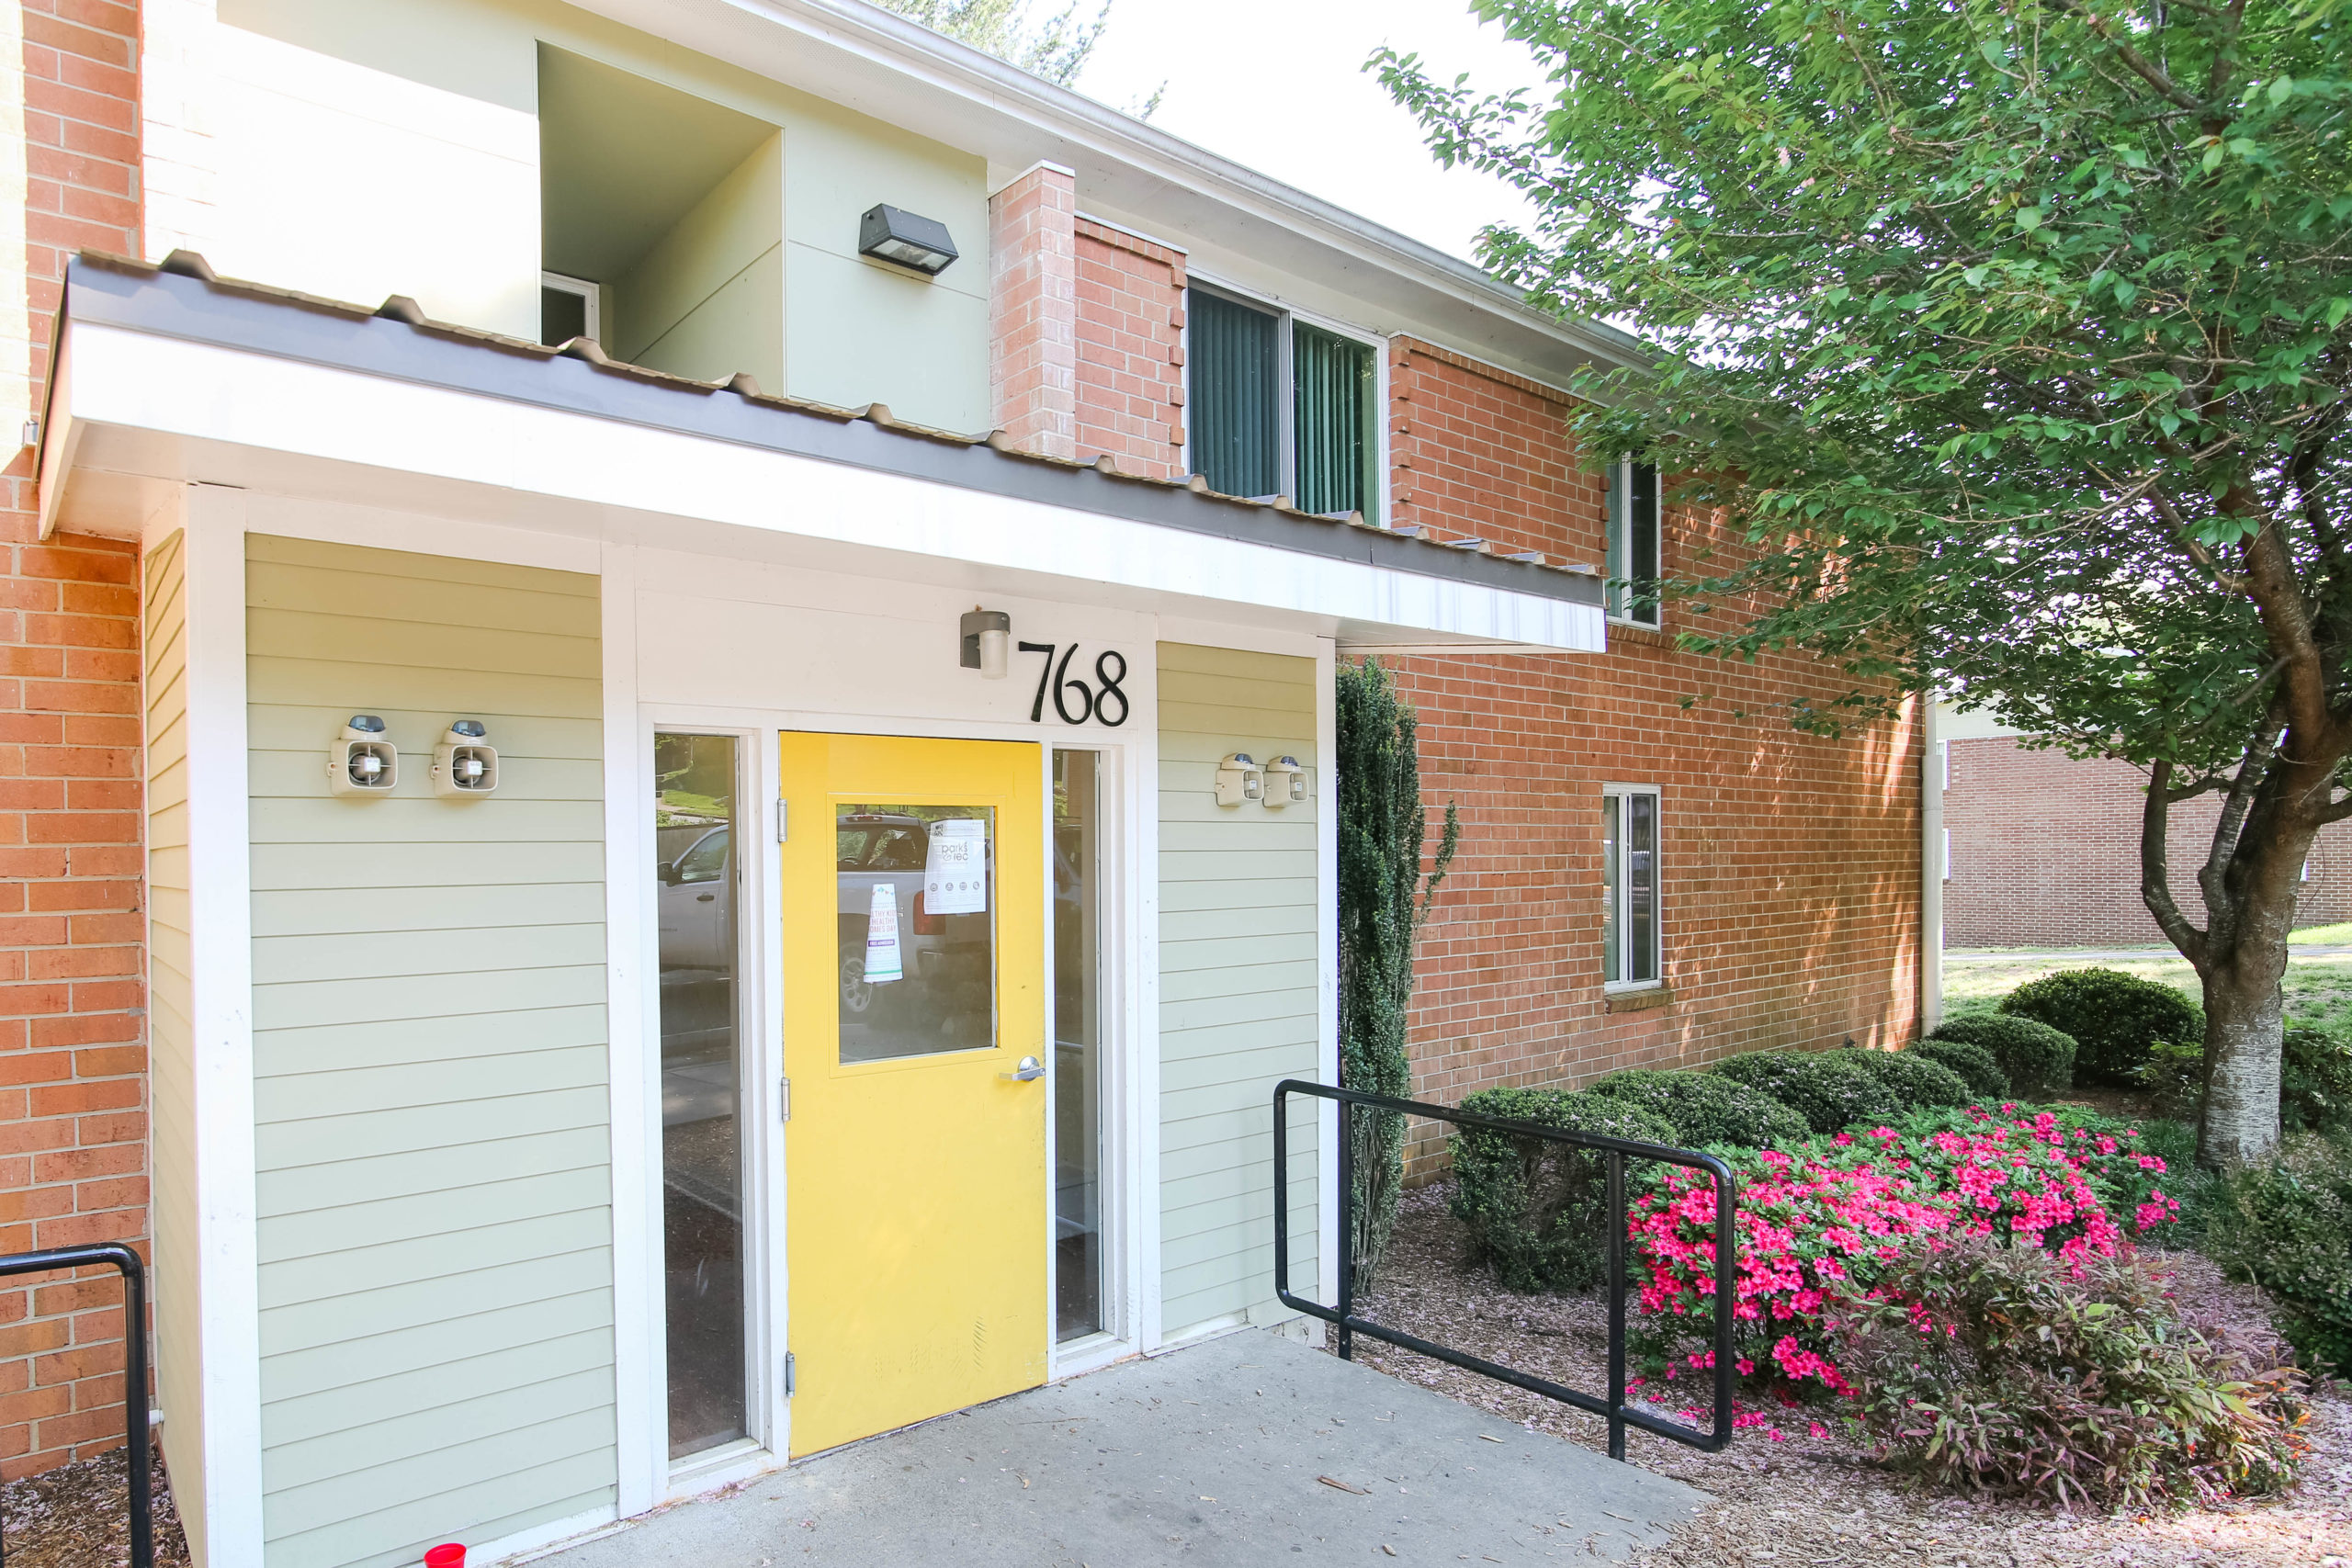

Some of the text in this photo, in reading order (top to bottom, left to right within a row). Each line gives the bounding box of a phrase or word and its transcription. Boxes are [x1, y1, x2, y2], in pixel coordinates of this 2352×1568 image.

[1018, 640, 1129, 728] 768
[942, 842, 968, 853] parks
[953, 852, 969, 861] rec
